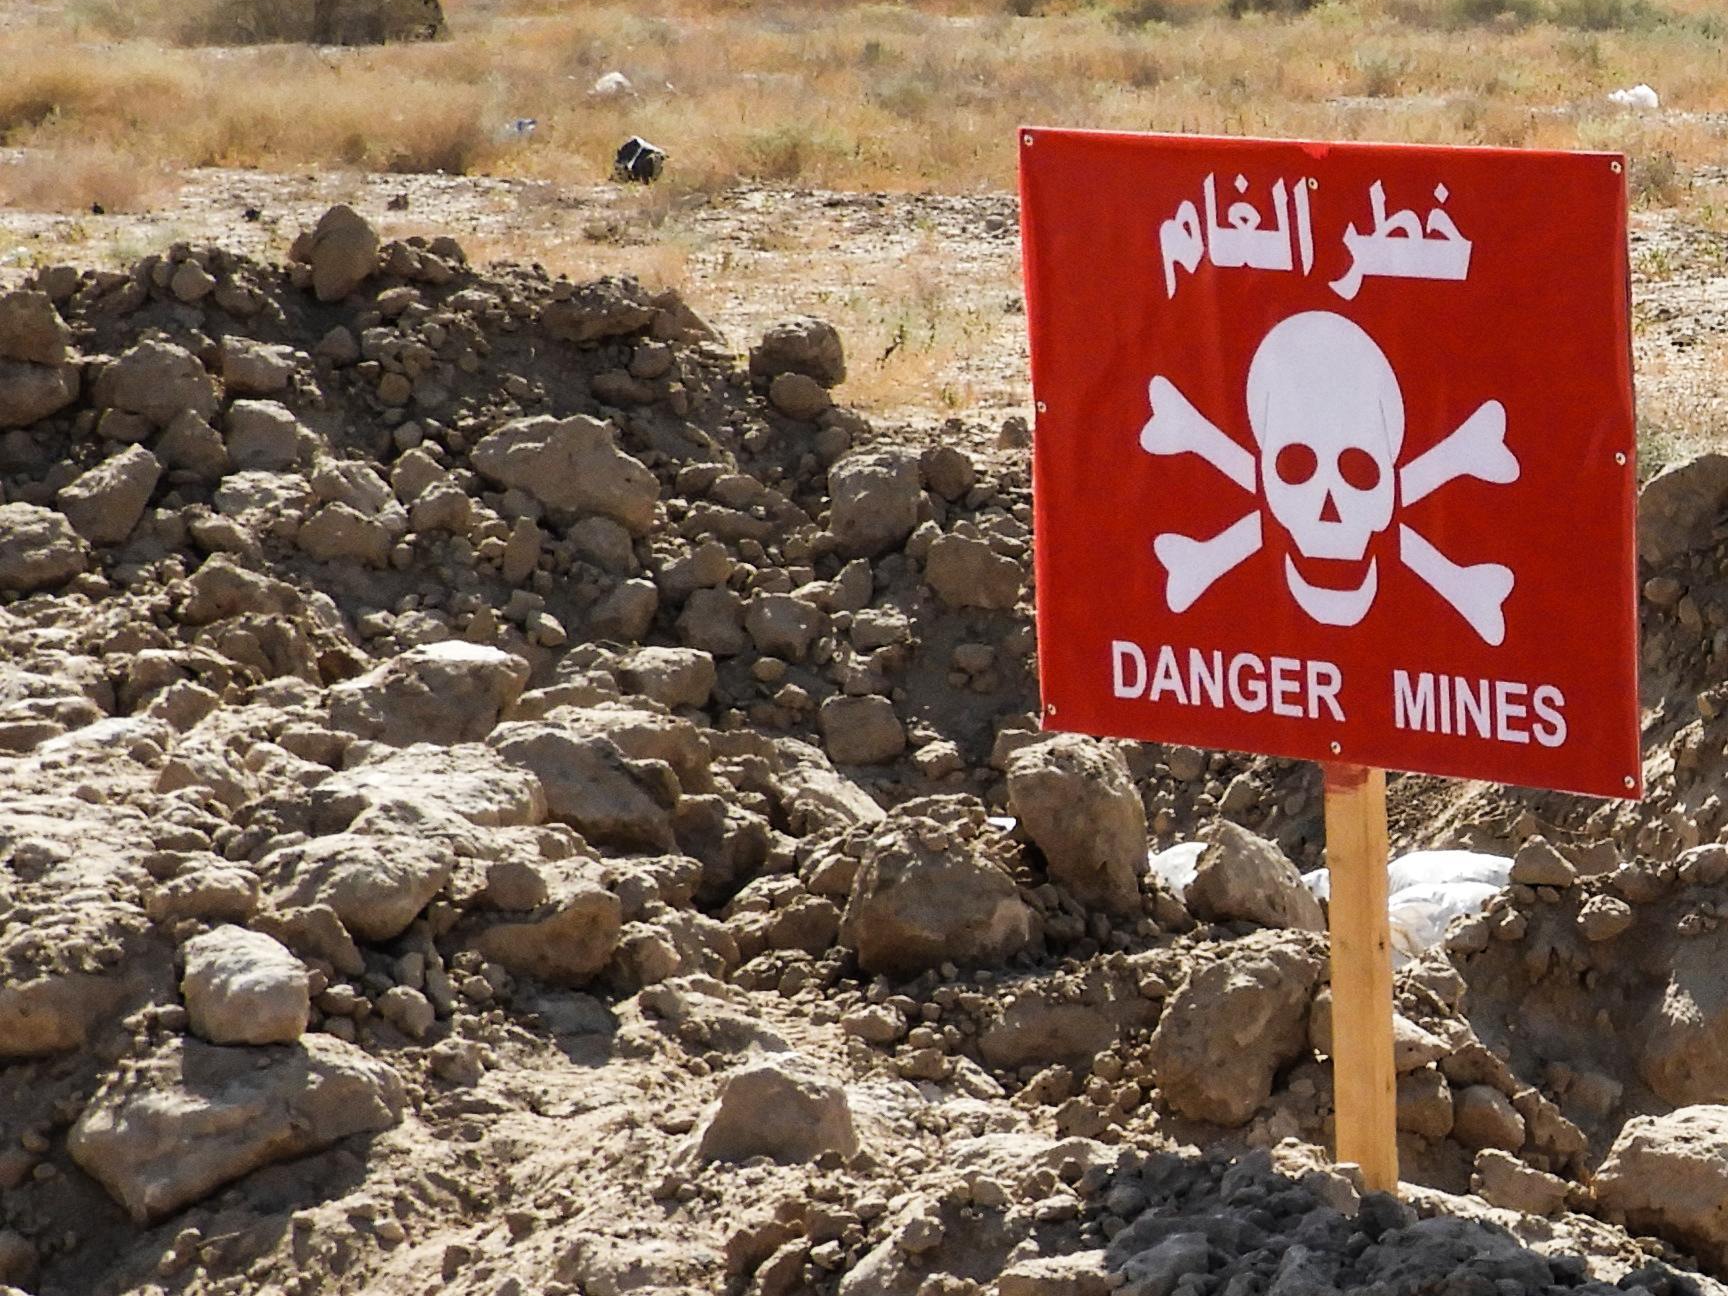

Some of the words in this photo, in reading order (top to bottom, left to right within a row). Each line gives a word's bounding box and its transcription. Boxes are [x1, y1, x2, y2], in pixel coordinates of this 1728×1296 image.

[1328, 179, 1473, 301] خطر
[1111, 640, 1346, 722] DANGER
[1393, 669, 1568, 748] MINES
